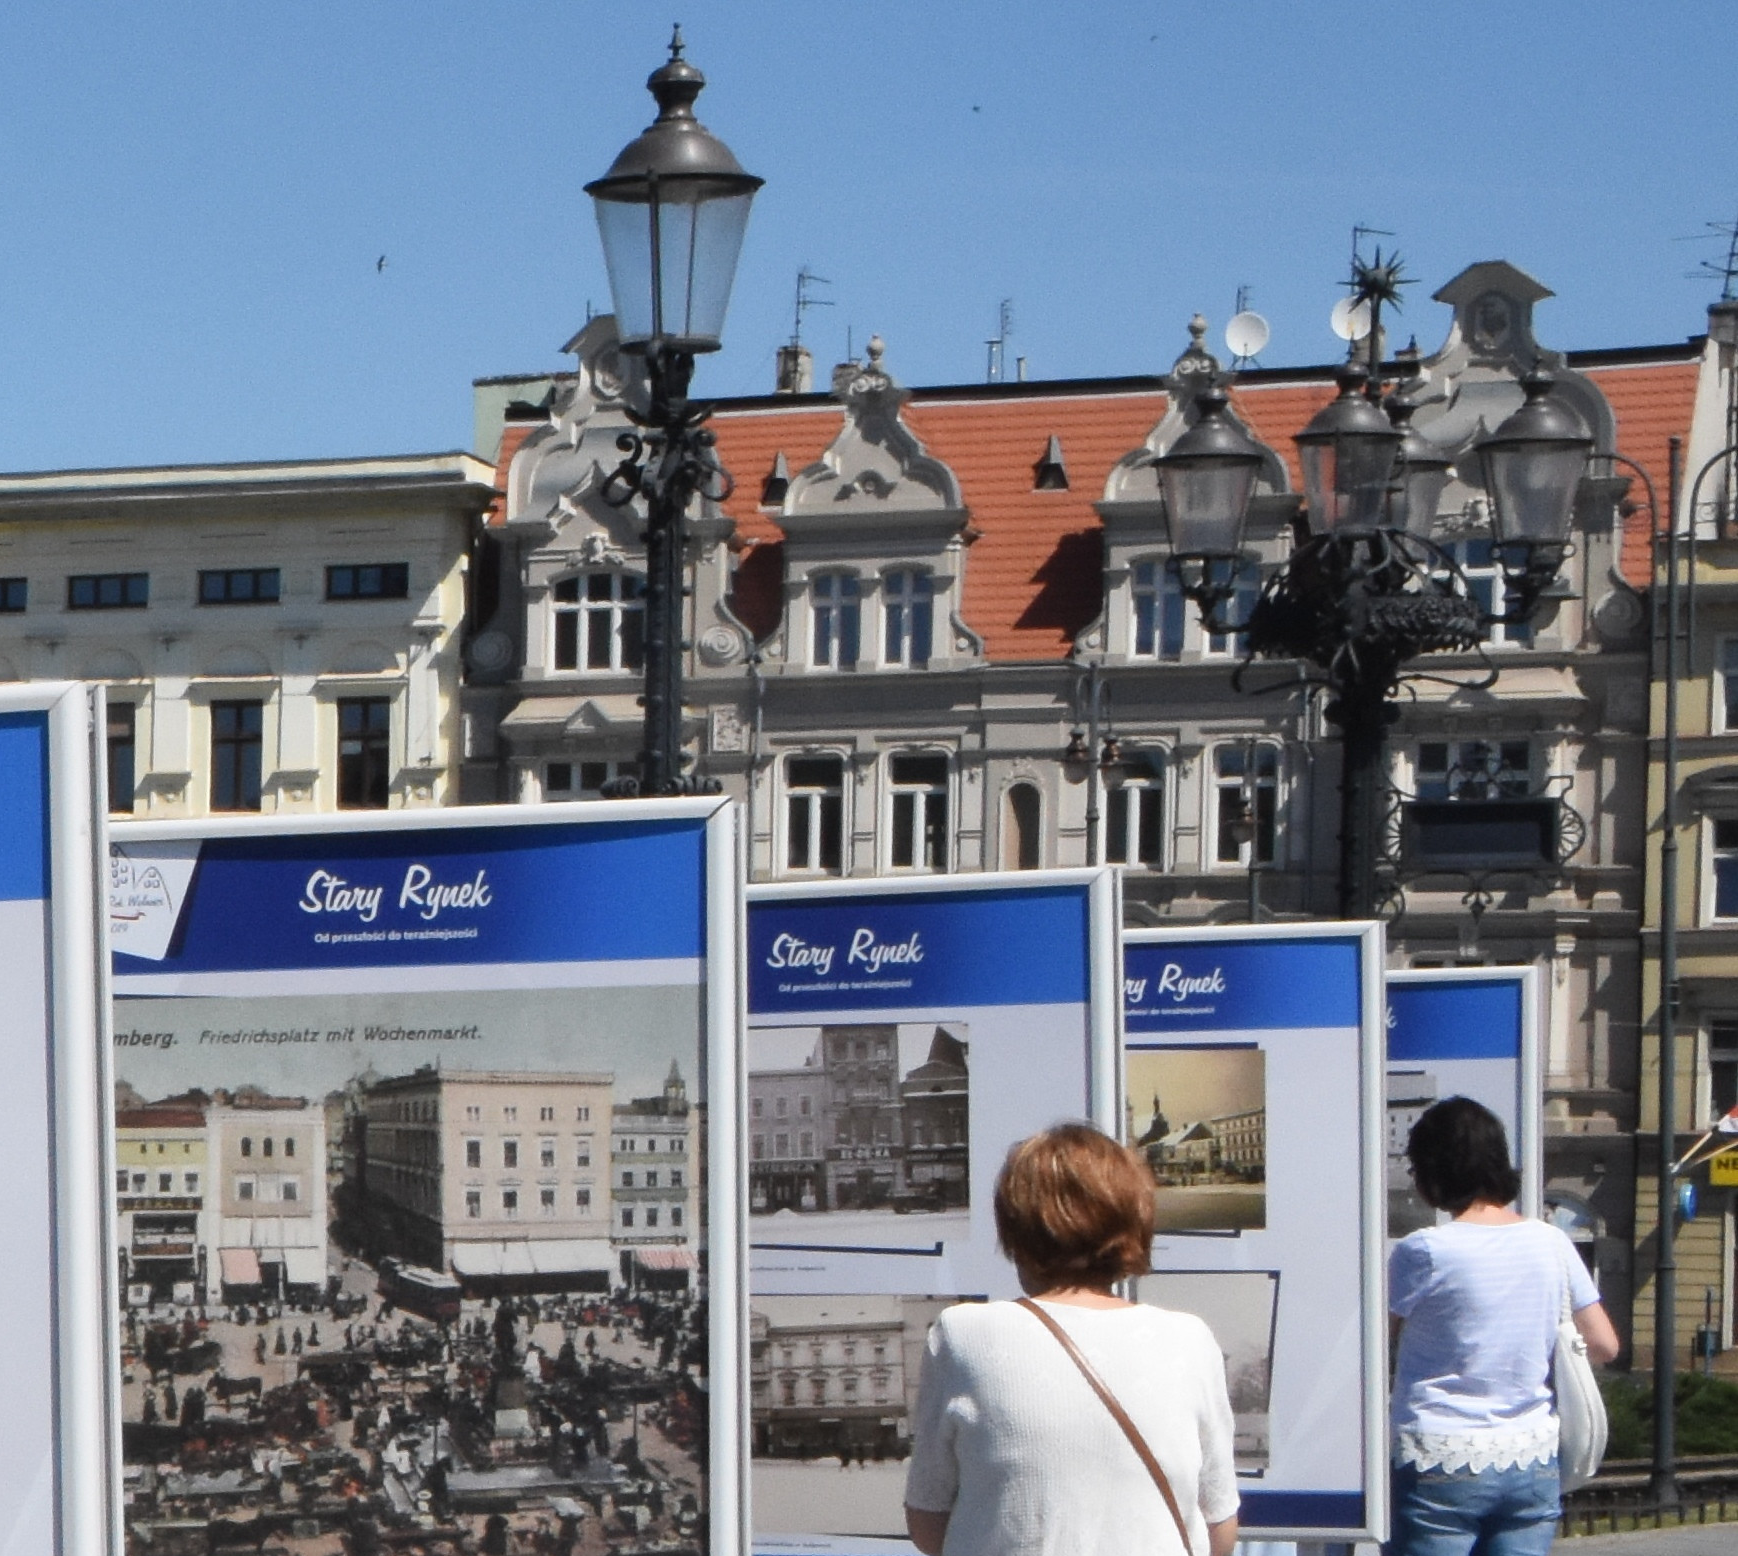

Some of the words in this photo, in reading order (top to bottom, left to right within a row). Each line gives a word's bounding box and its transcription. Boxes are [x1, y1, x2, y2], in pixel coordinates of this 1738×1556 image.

[298, 869, 383, 924] Stary
[399, 864, 492, 920] Rynek
[313, 932, 329, 943] Od
[387, 929, 401, 940] do
[766, 933, 835, 975] Stary
[847, 928, 924, 974] Rynek
[1158, 963, 1226, 1002] Rynek
[113, 1029, 178, 1049] mberg.
[326, 1026, 354, 1042] mit
